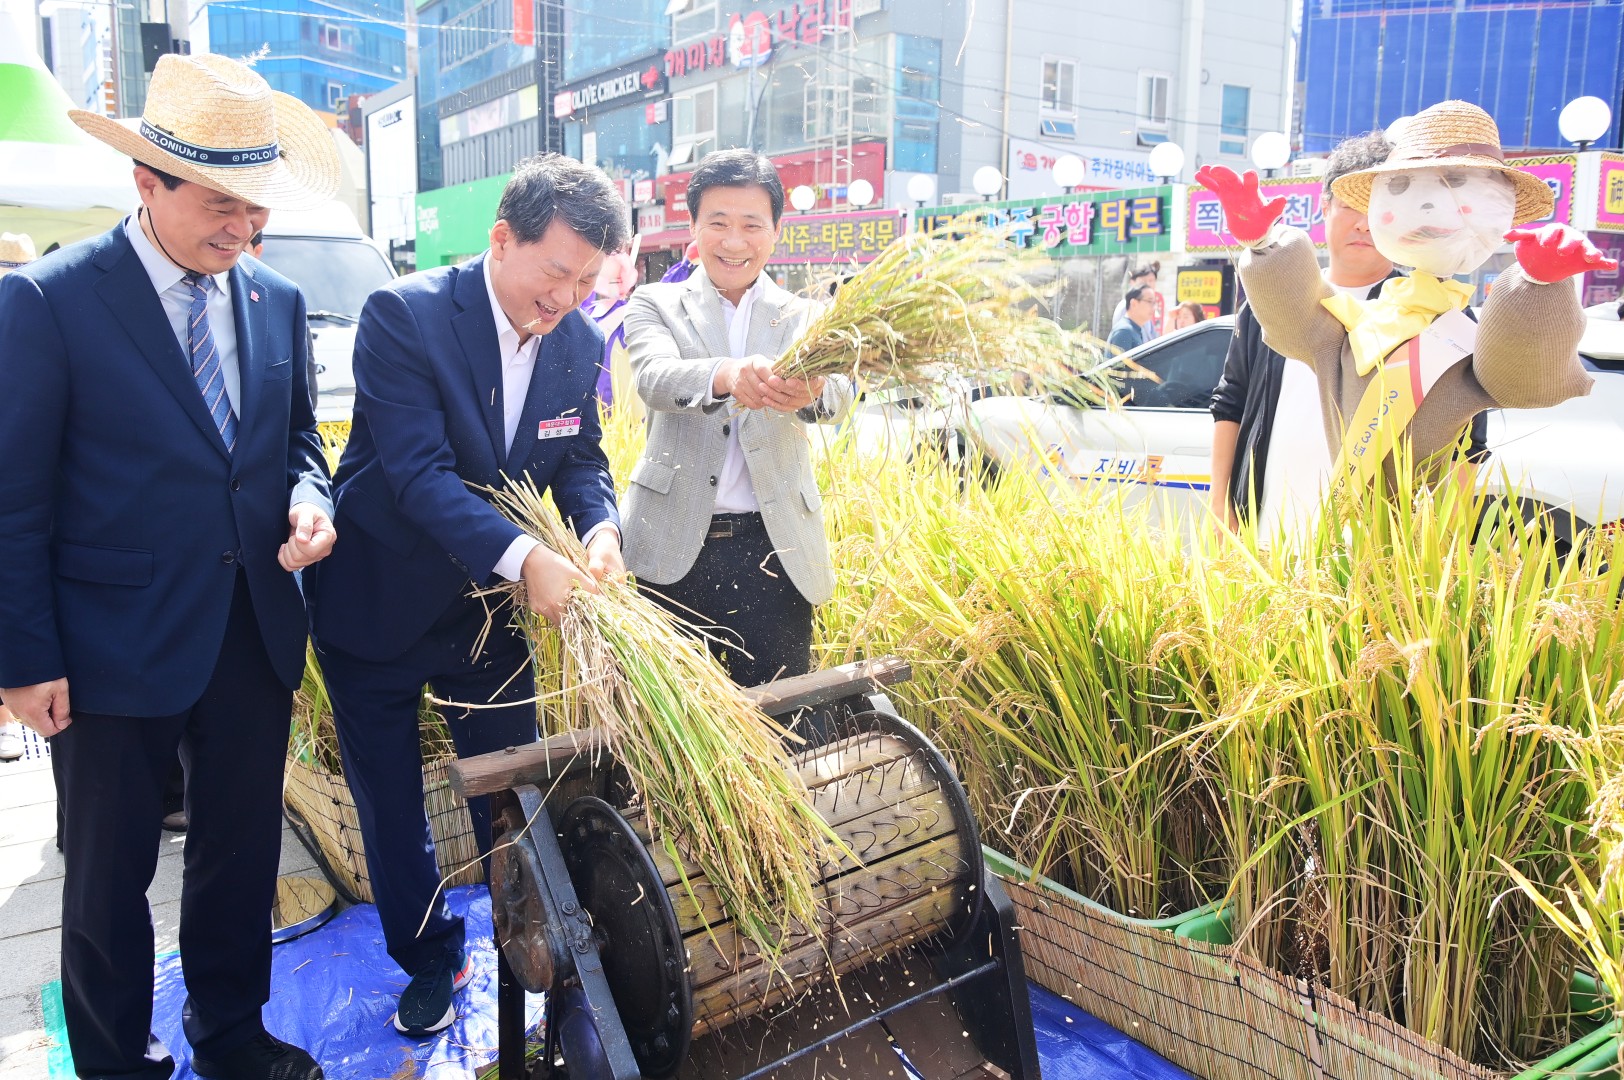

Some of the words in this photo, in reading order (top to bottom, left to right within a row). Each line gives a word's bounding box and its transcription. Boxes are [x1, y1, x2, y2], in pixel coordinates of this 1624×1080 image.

[664, 34, 725, 77] 개미집
[572, 84, 598, 110] OLIVE
[597, 71, 641, 103] CHICKEN
[144, 127, 198, 159] POLONIUM
[858, 219, 895, 252] 전문
[1039, 200, 1095, 248] 궁합
[1100, 195, 1163, 243] 타로
